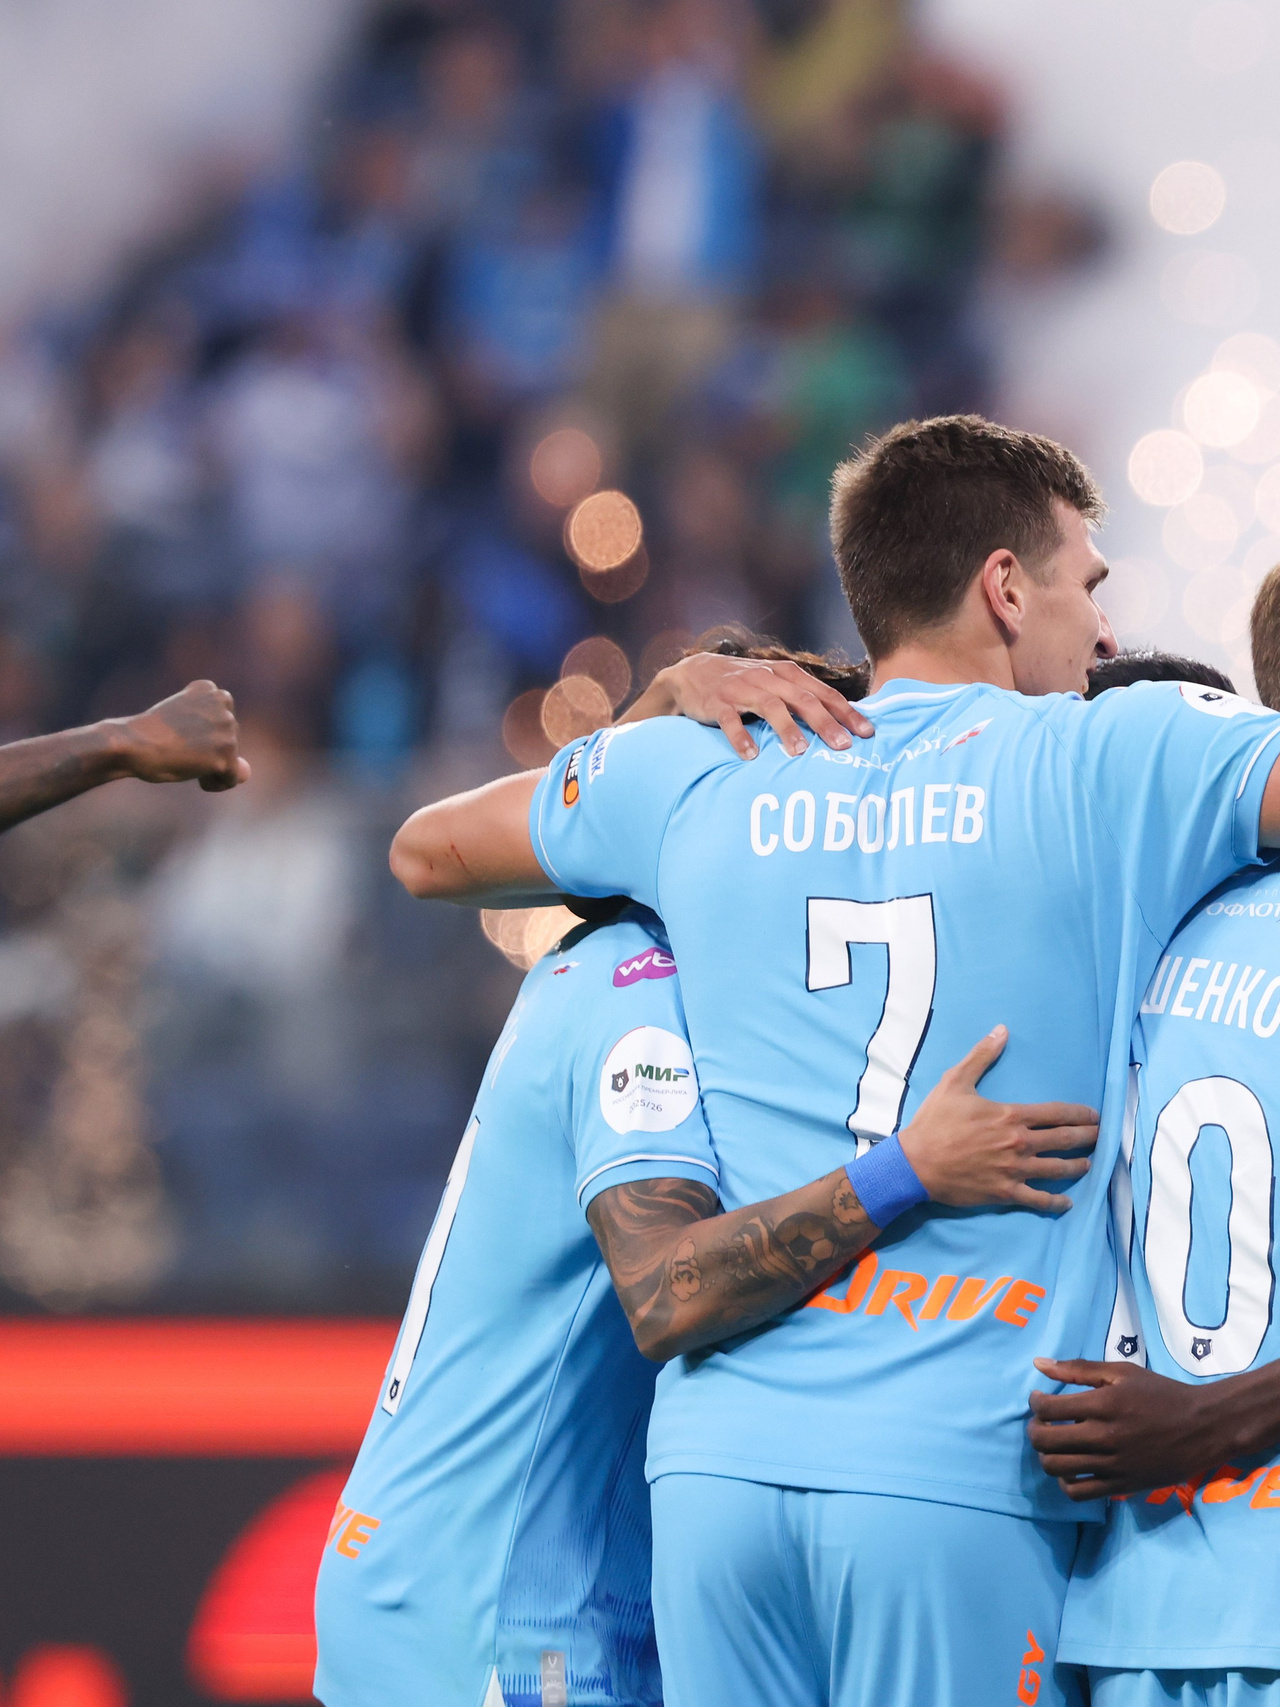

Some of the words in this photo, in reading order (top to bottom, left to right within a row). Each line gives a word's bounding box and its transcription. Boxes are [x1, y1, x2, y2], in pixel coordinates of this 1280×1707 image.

[750, 783, 986, 857] СОБОЛЕВ
[805, 892, 937, 1162] 7
[635, 1063, 690, 1082] МИР
